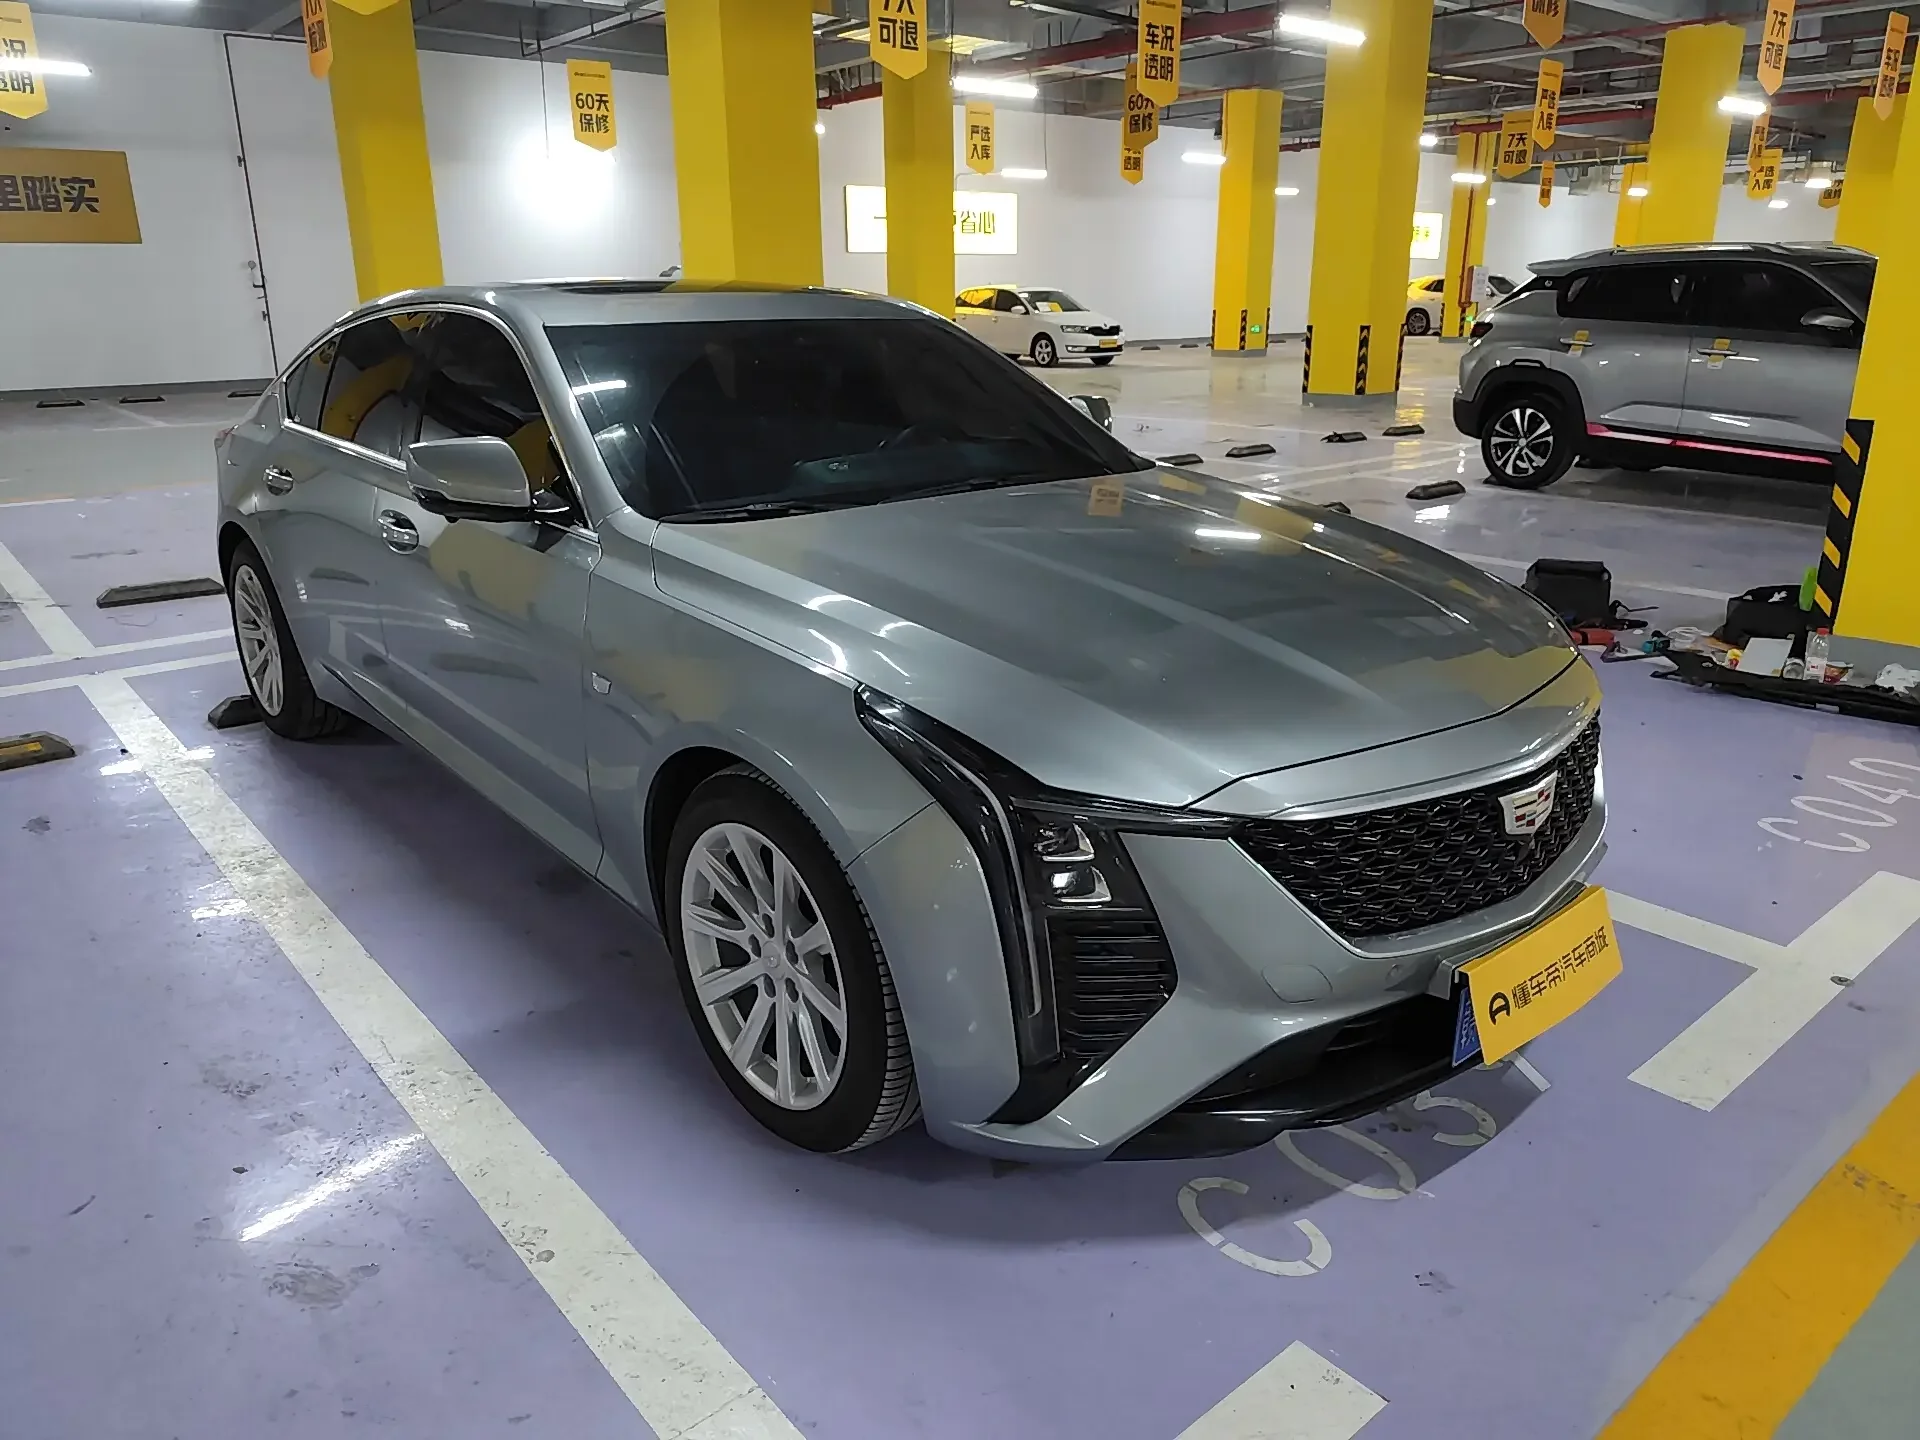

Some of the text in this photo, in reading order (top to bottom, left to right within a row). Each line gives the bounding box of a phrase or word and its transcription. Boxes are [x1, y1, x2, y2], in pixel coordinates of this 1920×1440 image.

[878, 17, 919, 51] 可退
[1770, 9, 1788, 39] 7天
[1145, 22, 1175, 51] 车况
[0, 38, 27, 60] 况
[1764, 41, 1784, 70] 可退
[1145, 53, 1174, 82] 透明
[575, 92, 610, 112] 60天
[579, 113, 610, 133] 保修
[1130, 113, 1153, 133] 保修
[1537, 111, 1554, 131] 入库
[970, 125, 991, 142] 严选
[1507, 132, 1528, 148] 7天
[970, 144, 991, 160] 入库
[1503, 149, 1527, 165] 可退
[0, 176, 99, 213] 里踏实
[953, 210, 996, 234] 省心
[1511, 925, 1610, 1009] 懂车帝汽车商城
[1177, 1053, 1551, 1277] C05
